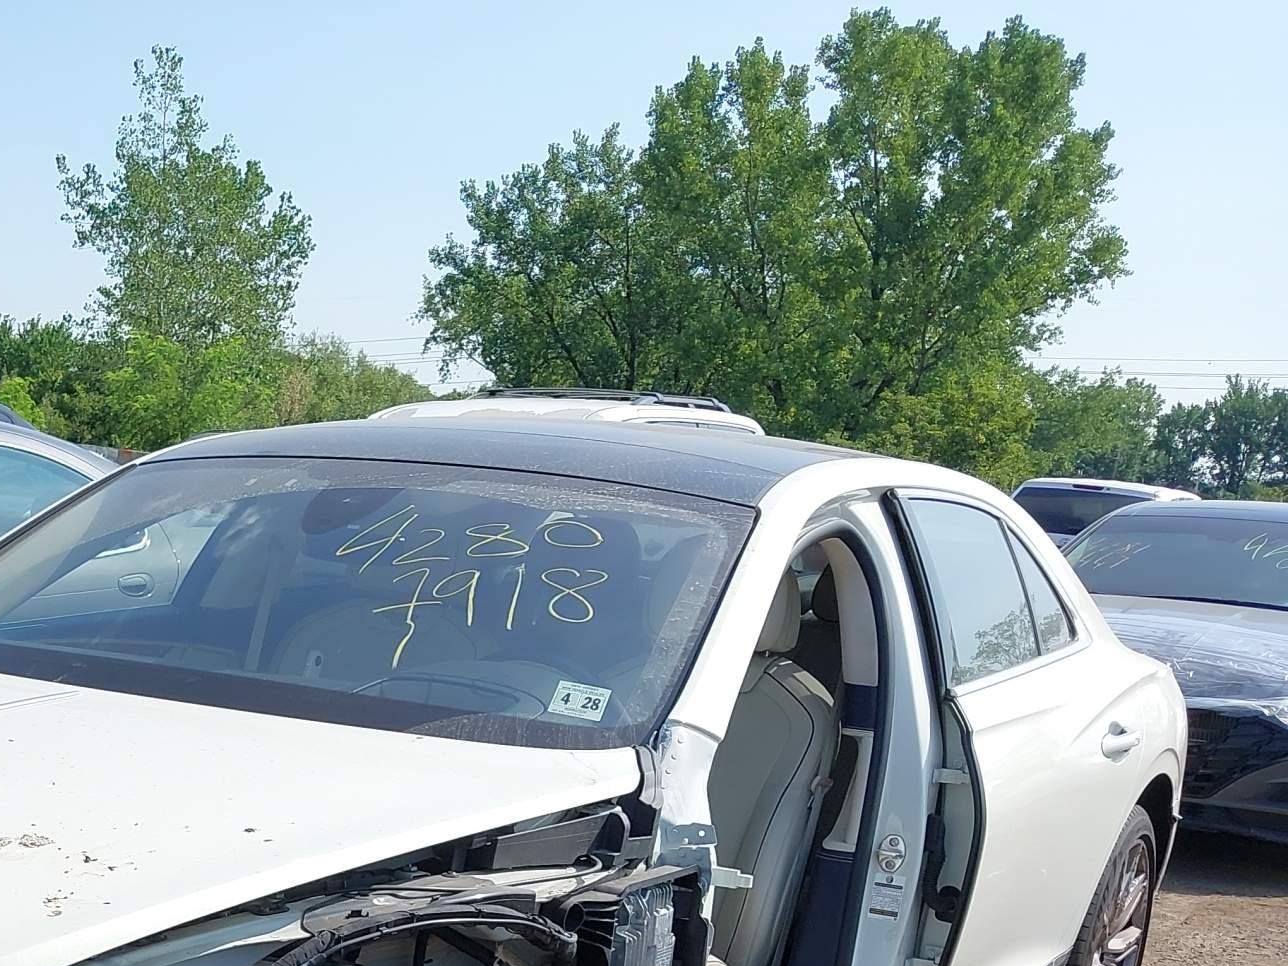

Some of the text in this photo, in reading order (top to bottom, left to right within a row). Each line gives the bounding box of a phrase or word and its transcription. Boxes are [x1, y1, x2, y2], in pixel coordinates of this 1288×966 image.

[336, 504, 604, 575] 4280
[372, 563, 609, 669] 7918
[560, 692, 601, 711] 4 28
